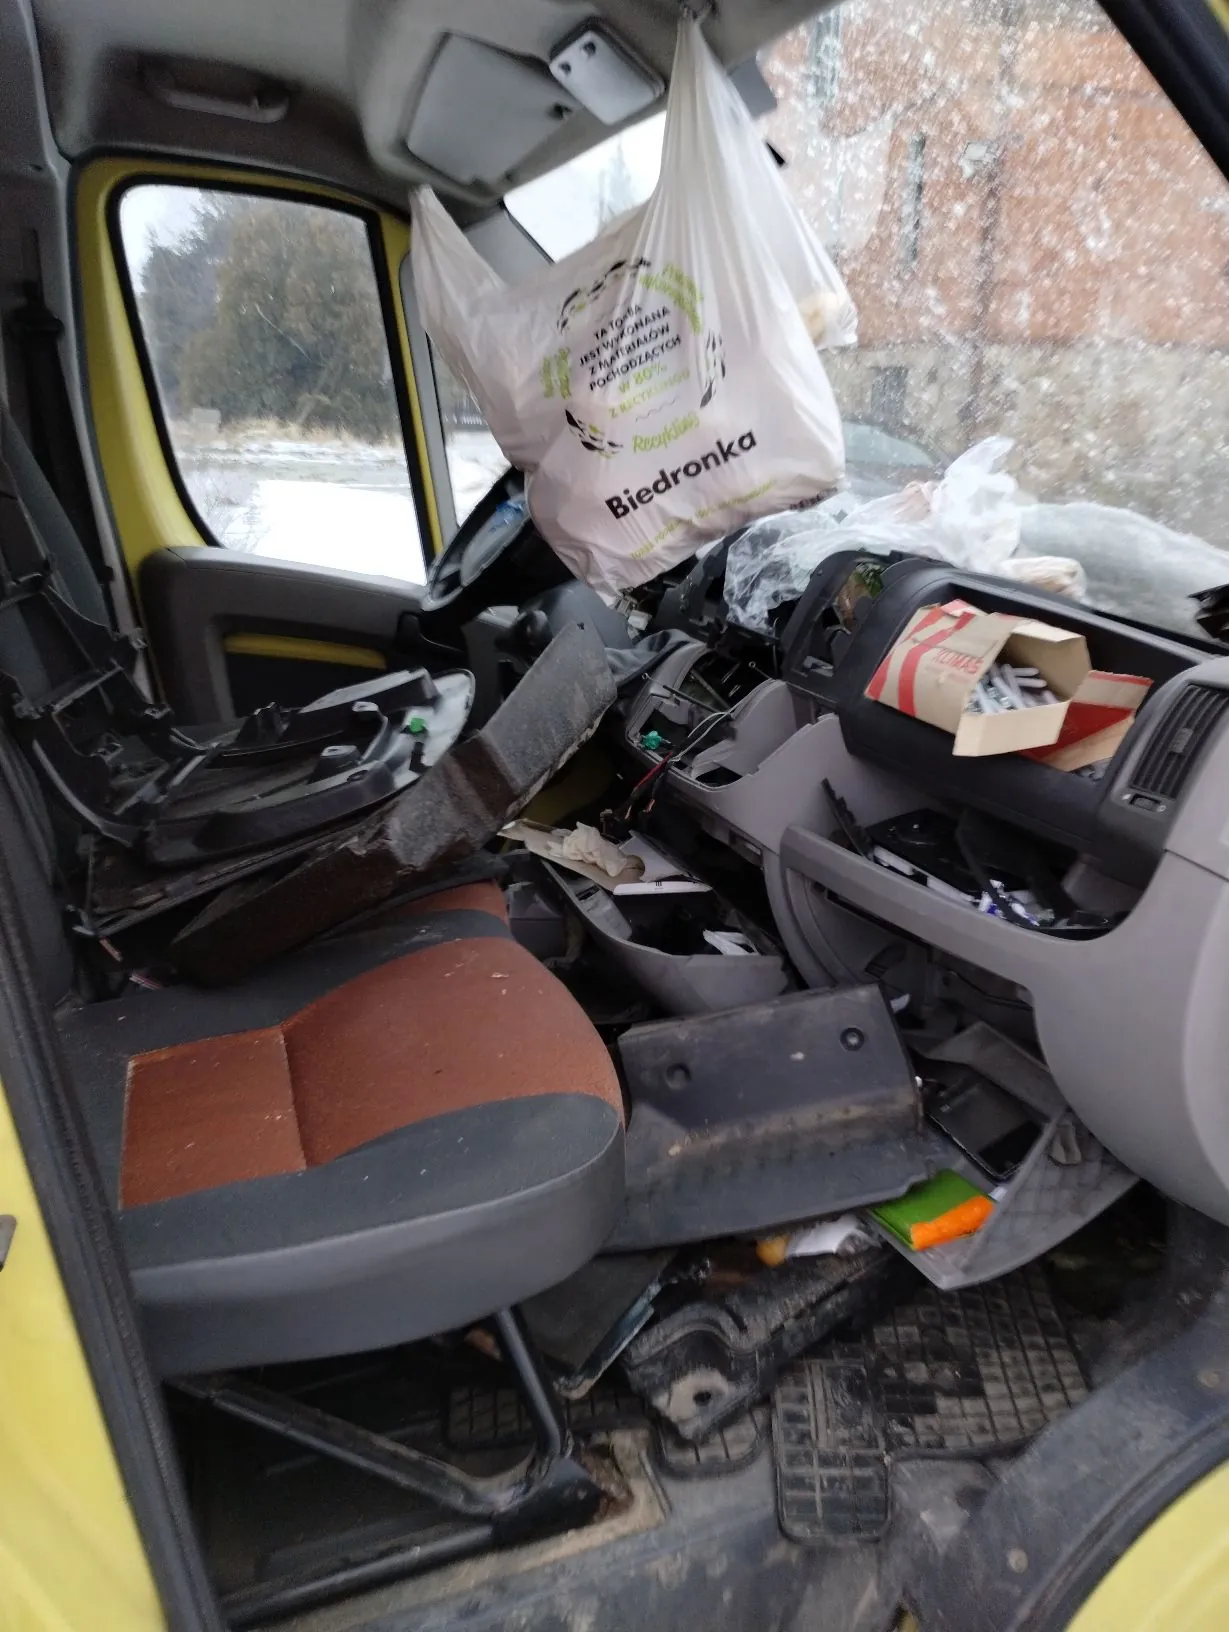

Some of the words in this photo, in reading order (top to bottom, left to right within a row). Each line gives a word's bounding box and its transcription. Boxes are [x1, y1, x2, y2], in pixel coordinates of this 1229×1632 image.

[580, 346, 601, 367] JEST
[602, 305, 671, 351] WYKONANA
[594, 328, 607, 340] TA
[588, 366, 597, 377] Z
[604, 426, 758, 520] Biedronka
